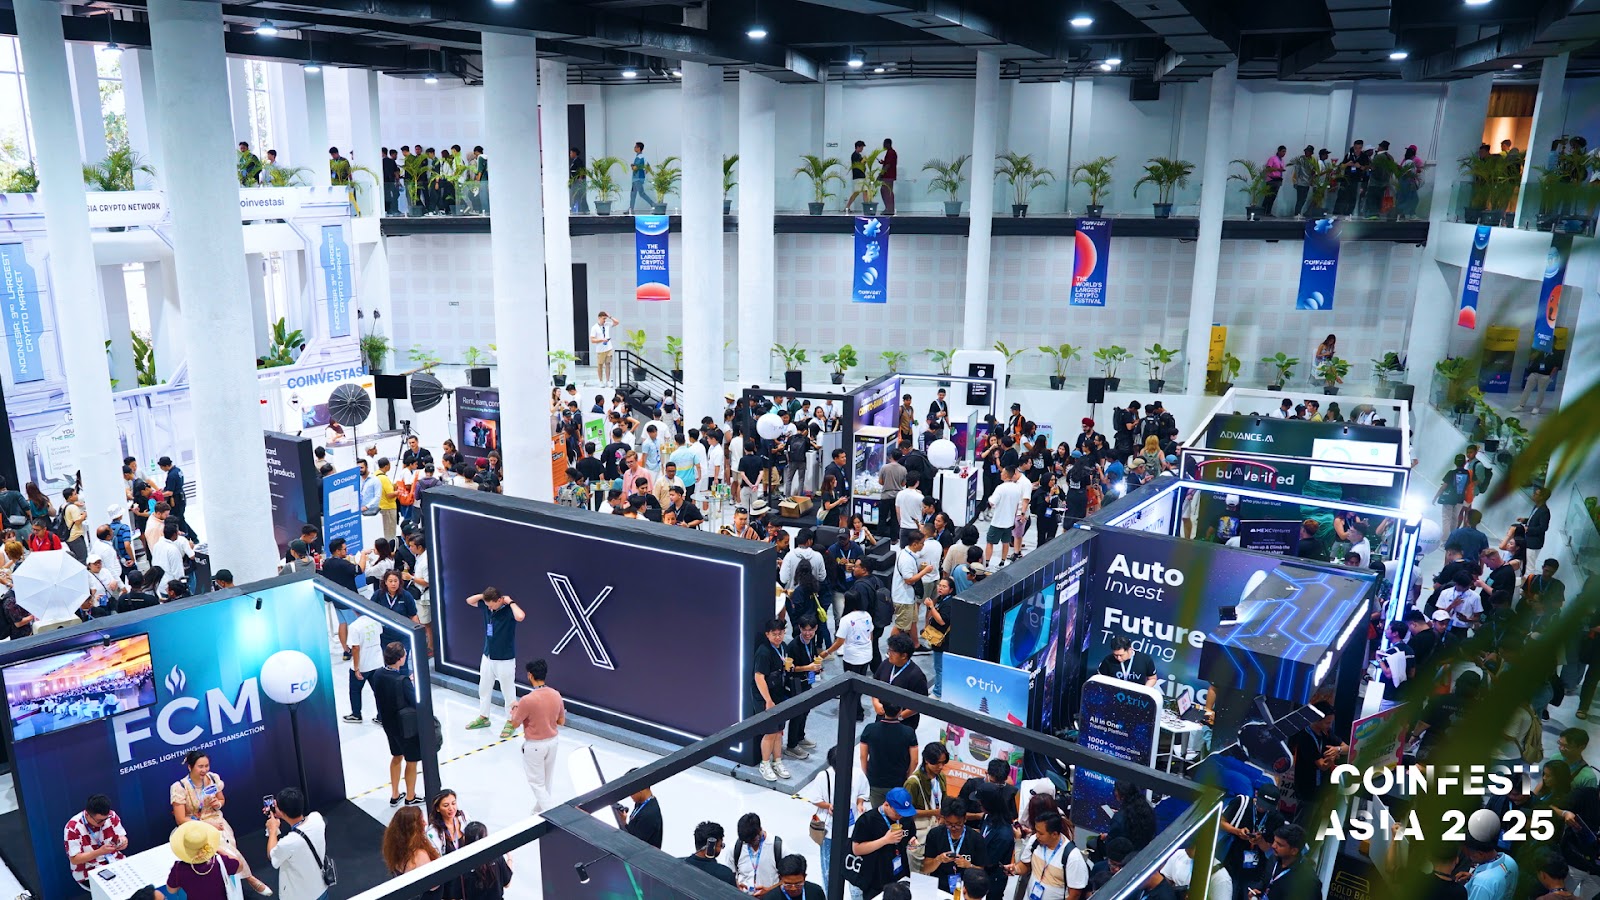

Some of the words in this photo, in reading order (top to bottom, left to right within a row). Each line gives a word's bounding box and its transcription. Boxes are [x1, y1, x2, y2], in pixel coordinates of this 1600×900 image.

[88, 204, 98, 212] SIA
[100, 204, 126, 212] CRYPTO
[128, 202, 160, 210] NETWORK
[240, 196, 284, 207] oinvestasi
[1, 252, 16, 300] LARGEST
[14, 270, 26, 311] MARKET
[22, 312, 34, 352] CRYPTO
[288, 366, 368, 389] COINVESTASI
[274, 468, 295, 478] products
[1106, 554, 1184, 586] Auto
[1104, 576, 1164, 601] Invest
[547, 572, 615, 670] X
[1103, 606, 1206, 648] Future
[1101, 630, 1176, 662] Tding
[978, 680, 1002, 694] triv
[1127, 695, 1149, 708] triv
[112, 677, 262, 764] FCM
[1089, 722, 1107, 732] Trading
[1108, 727, 1128, 737] Platform
[120, 758, 158, 775] SEAMLESS,
[218, 725, 265, 744] TRANSACTION
[1087, 742, 1103, 751] 100+
[1088, 736, 1108, 746] 1000+
[1084, 770, 1102, 780] While
[1103, 777, 1115, 785] You
